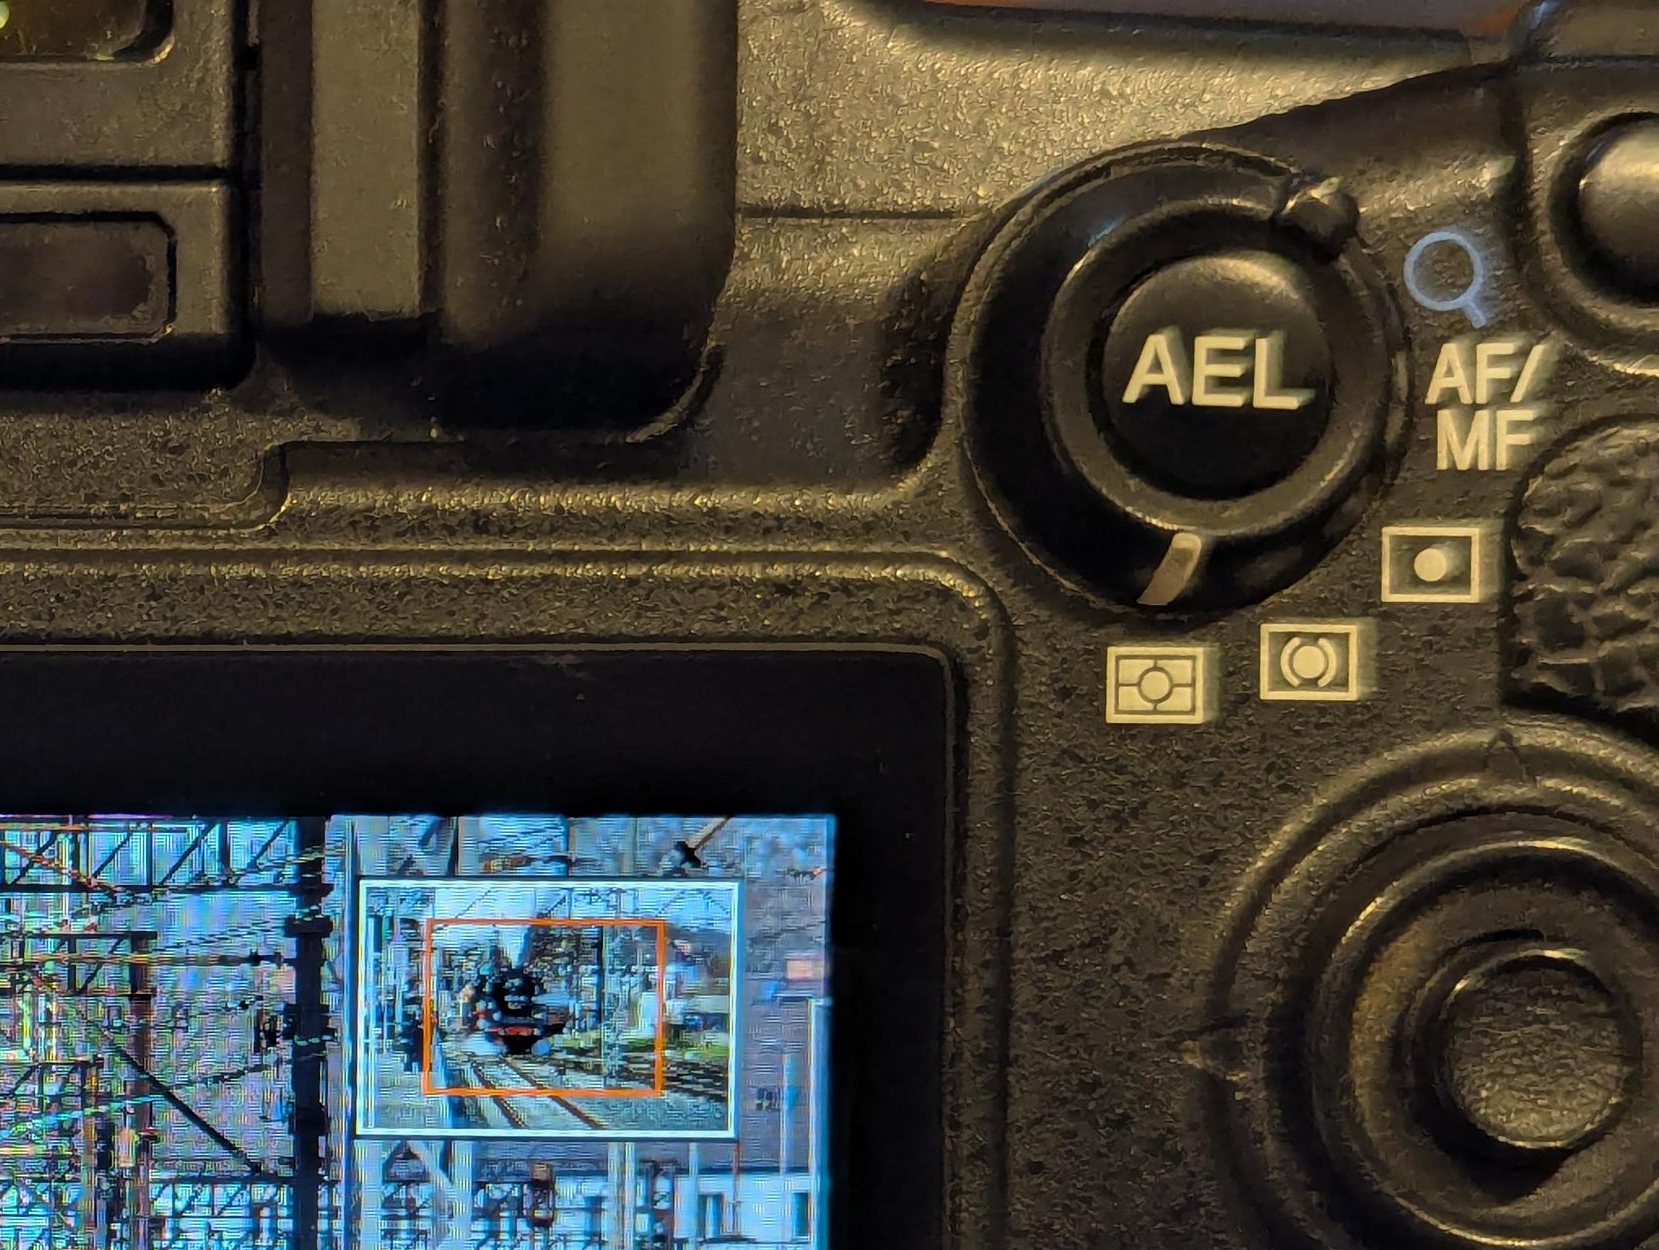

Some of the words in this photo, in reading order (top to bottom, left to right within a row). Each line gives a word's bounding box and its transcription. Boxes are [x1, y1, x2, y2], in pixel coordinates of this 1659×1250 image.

[1122, 335, 1312, 410] AEL
[1425, 342, 1548, 404] AF/
[1437, 409, 1537, 471] MF
